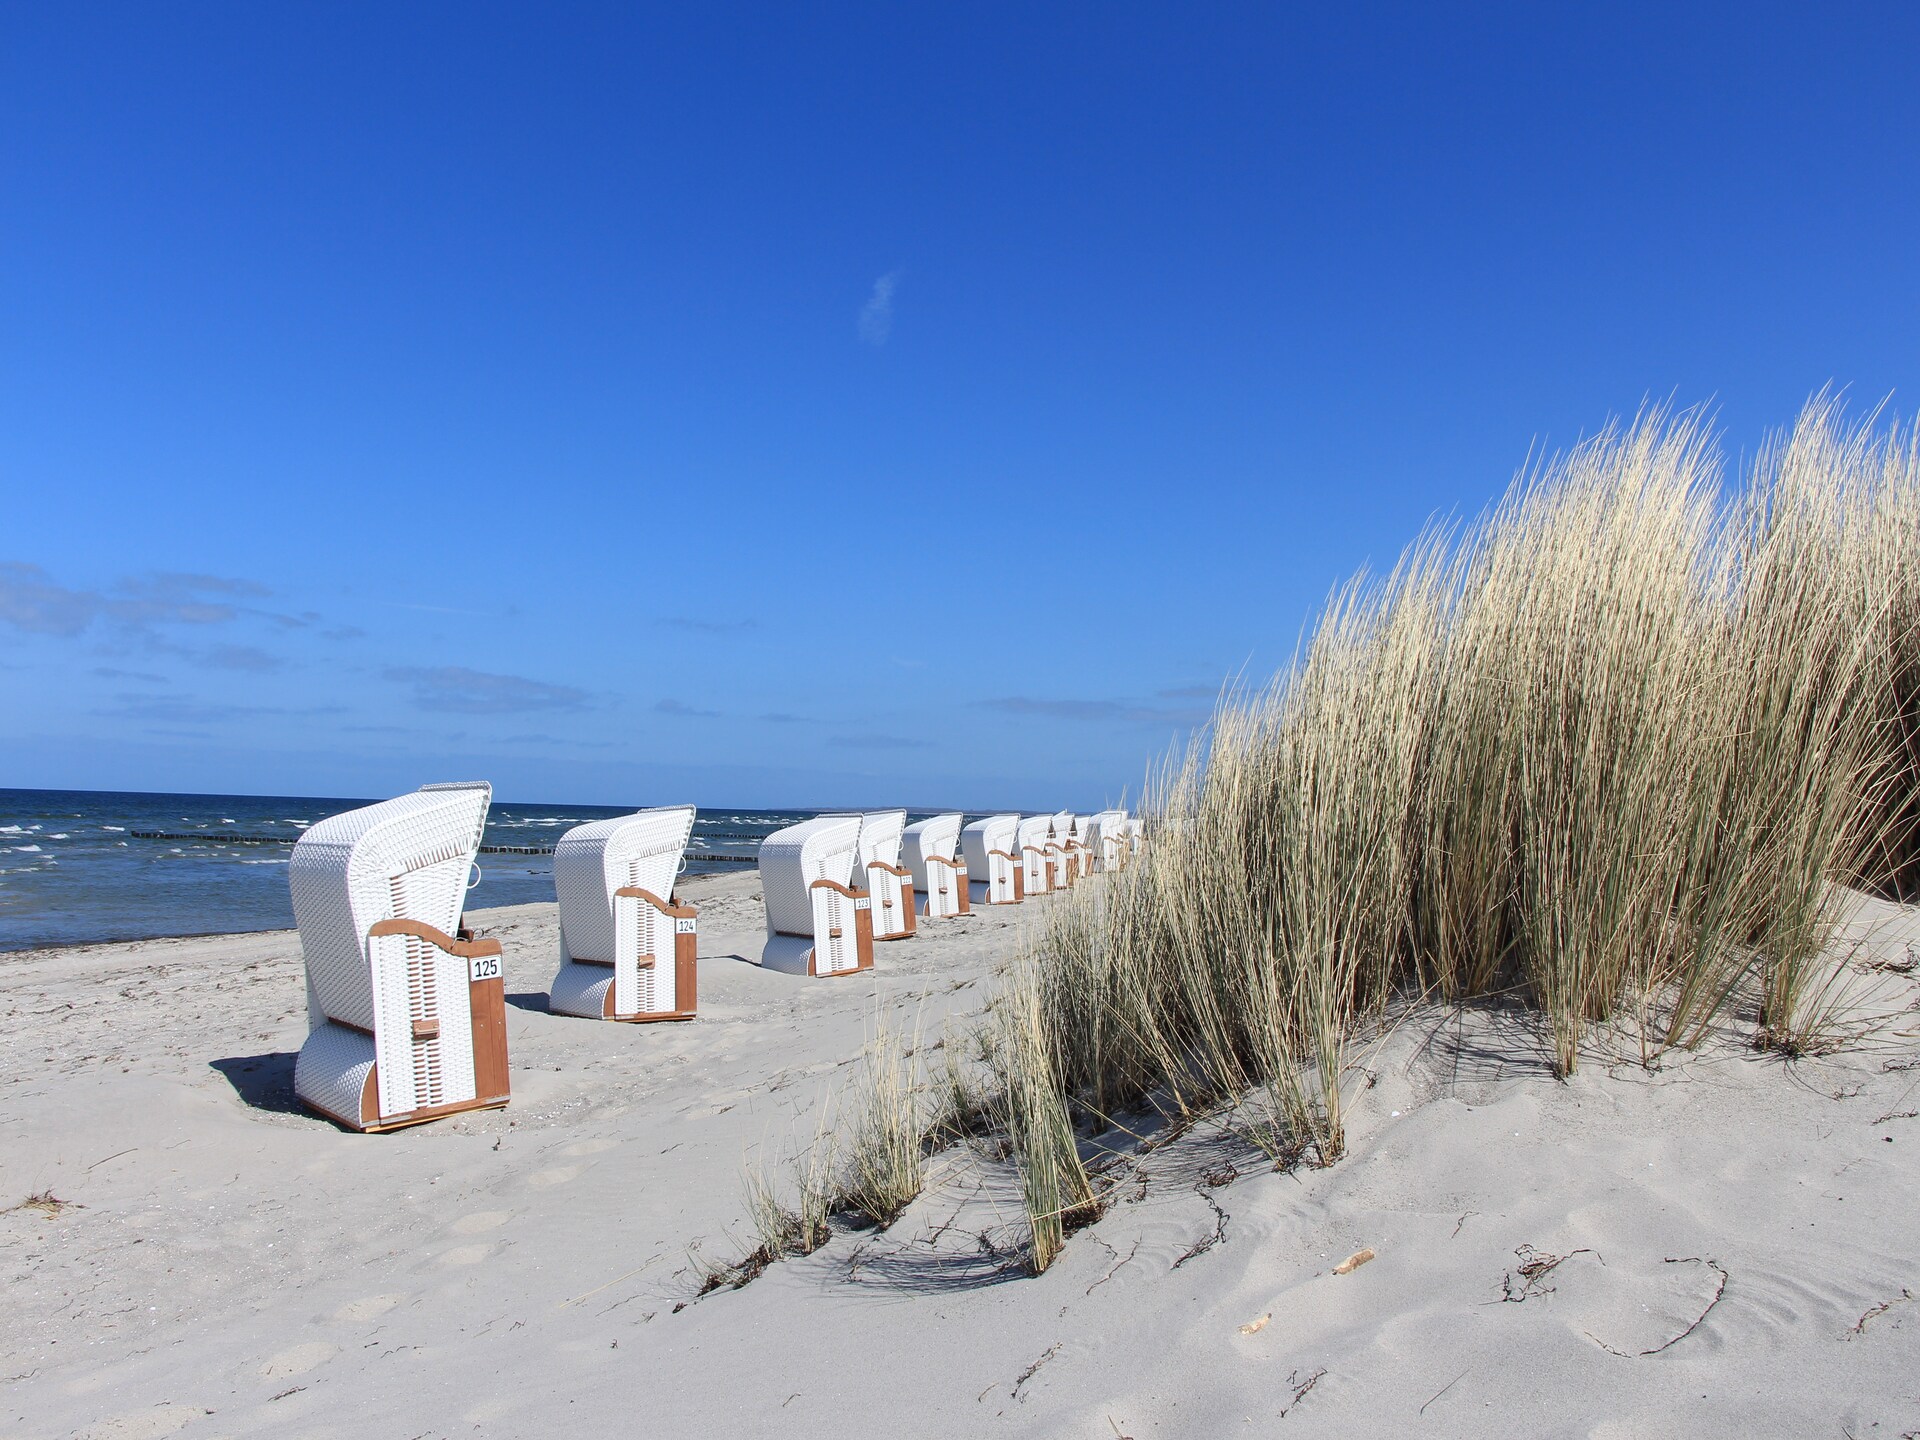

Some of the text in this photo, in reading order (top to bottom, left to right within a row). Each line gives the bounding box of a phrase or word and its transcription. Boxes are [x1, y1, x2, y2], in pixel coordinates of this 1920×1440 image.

[857, 899, 869, 908] 123
[679, 920, 694, 931] 124
[474, 959, 498, 977] 125
